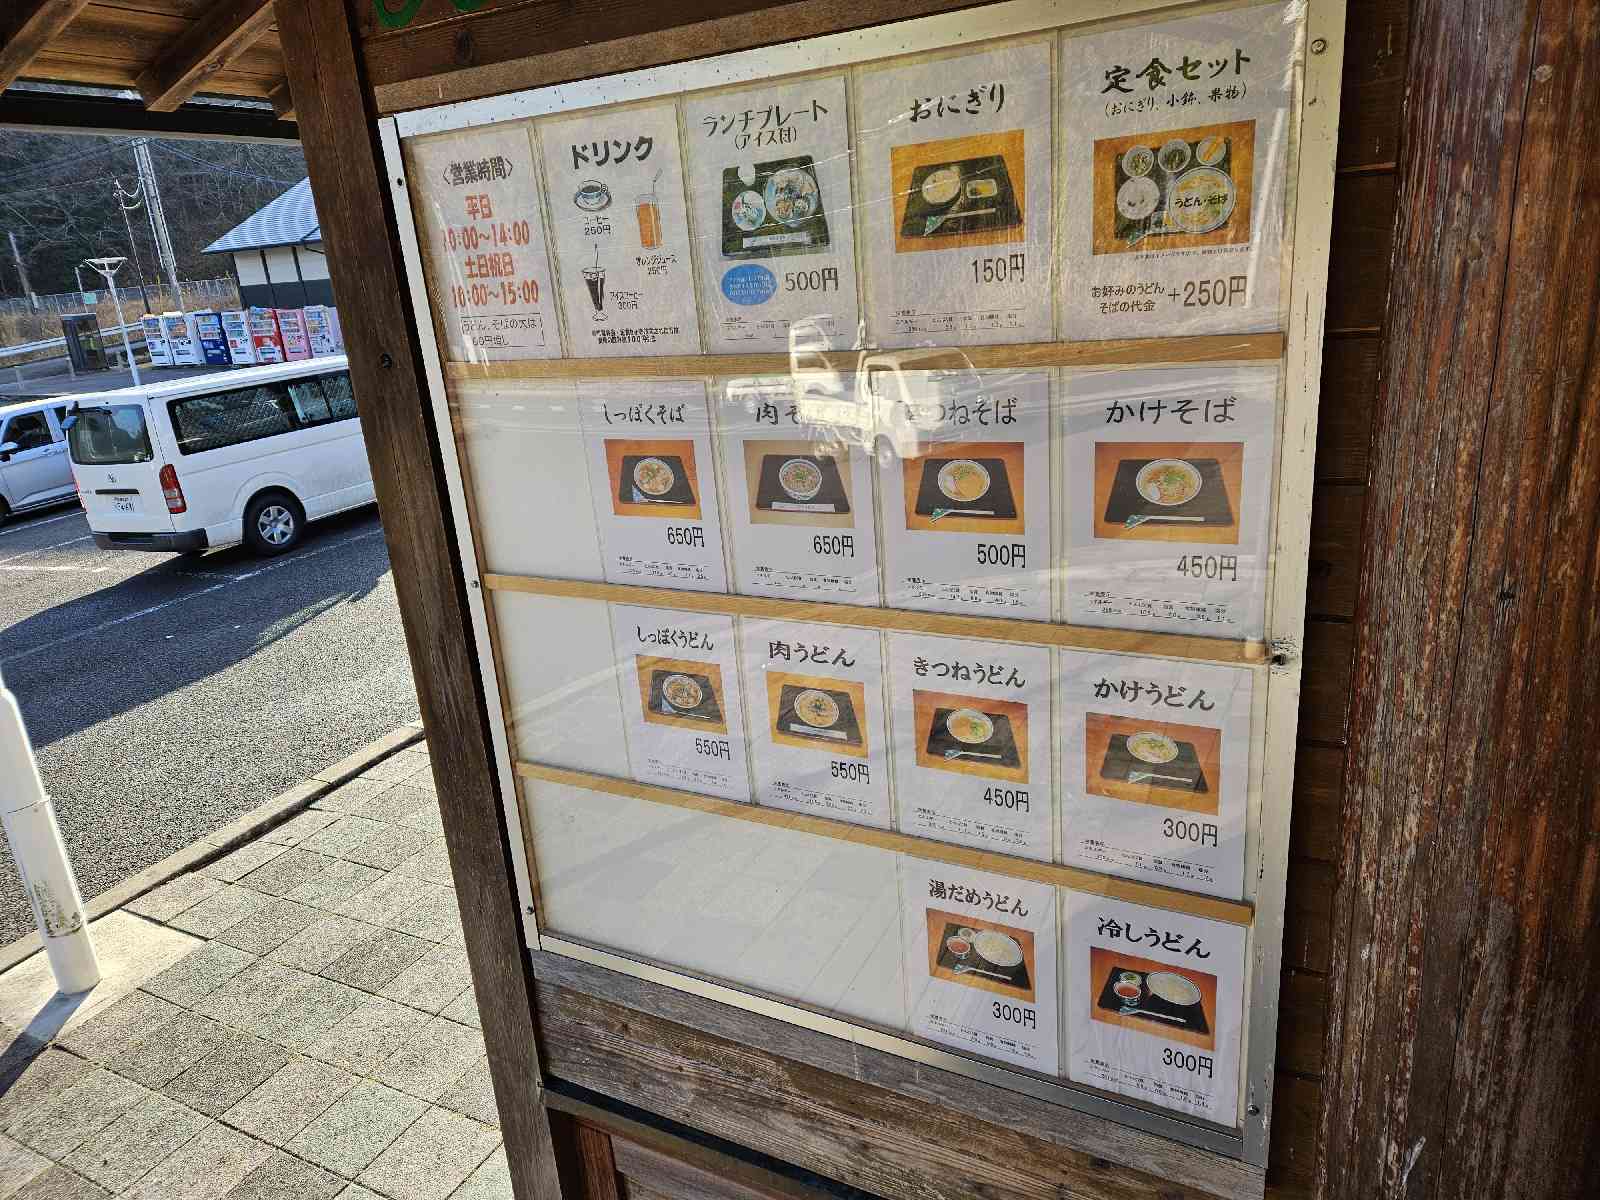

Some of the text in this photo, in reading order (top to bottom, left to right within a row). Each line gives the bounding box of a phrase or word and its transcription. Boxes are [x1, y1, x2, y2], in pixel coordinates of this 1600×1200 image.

[1100, 48, 1250, 94] 定食セット
[909, 82, 1005, 123] おにぎり
[703, 99, 828, 137] ランチプレート
[572, 136, 653, 170] ドリンク
[464, 193, 493, 220] 平日
[784, 267, 840, 292] 500円
[971, 253, 1026, 284] 150円
[1091, 280, 1165, 297] お好みのうどん
[1099, 300, 1155, 315] そばの代金
[602, 402, 687, 424] しっぽくそば
[1106, 397, 1237, 424] かけそば
[667, 526, 705, 548] 650円
[813, 535, 855, 558] 650円
[977, 543, 1026, 569] 500円
[1177, 555, 1237, 582] 450円
[637, 625, 714, 650] しっぽくうどん
[769, 640, 856, 668] 肉うどん
[913, 656, 1026, 689] きつねうどん
[1094, 677, 1215, 711] かけうどん
[695, 737, 731, 760] 550円
[831, 761, 870, 784] 550円
[984, 787, 1030, 813] 450円
[1163, 818, 1218, 848] 300円
[928, 879, 1029, 917] 湯だめうどん
[1097, 916, 1211, 959] 冷しうどん
[992, 1001, 1036, 1030] 300円
[1162, 1048, 1213, 1078] 300円
